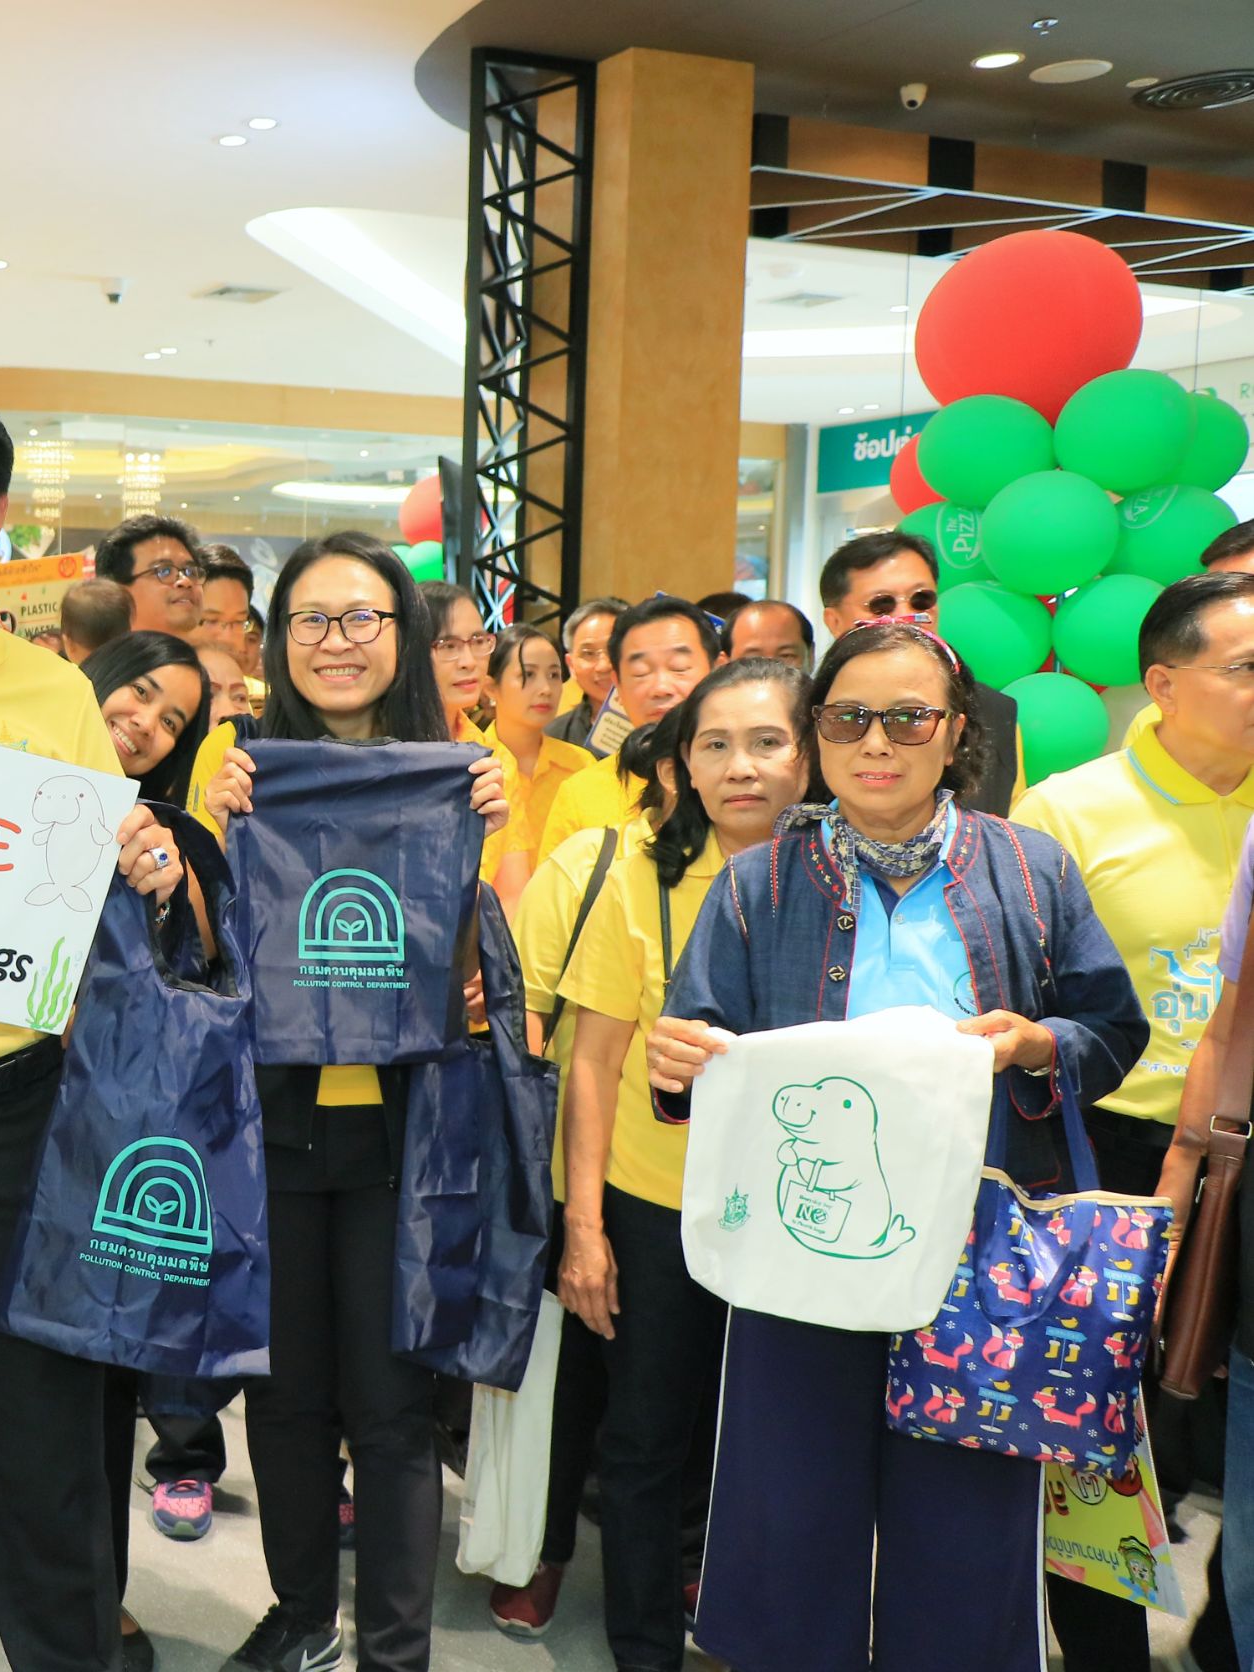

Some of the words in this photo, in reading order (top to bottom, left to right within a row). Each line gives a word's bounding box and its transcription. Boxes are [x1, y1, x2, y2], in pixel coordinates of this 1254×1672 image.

[20, 601, 58, 617] PLASTIC
[299, 964, 405, 981] กรมควบคุมมลพิษ
[293, 980, 330, 988] POLLUTION
[332, 980, 365, 989] CONTROL
[366, 981, 411, 990] DEPARTMENT
[89, 1237, 210, 1273] กรมควบคุมมลพิษ
[79, 1252, 123, 1270] POLLUTION
[124, 1264, 162, 1281] CONTROL
[163, 1273, 211, 1287] DEPARTMENT
